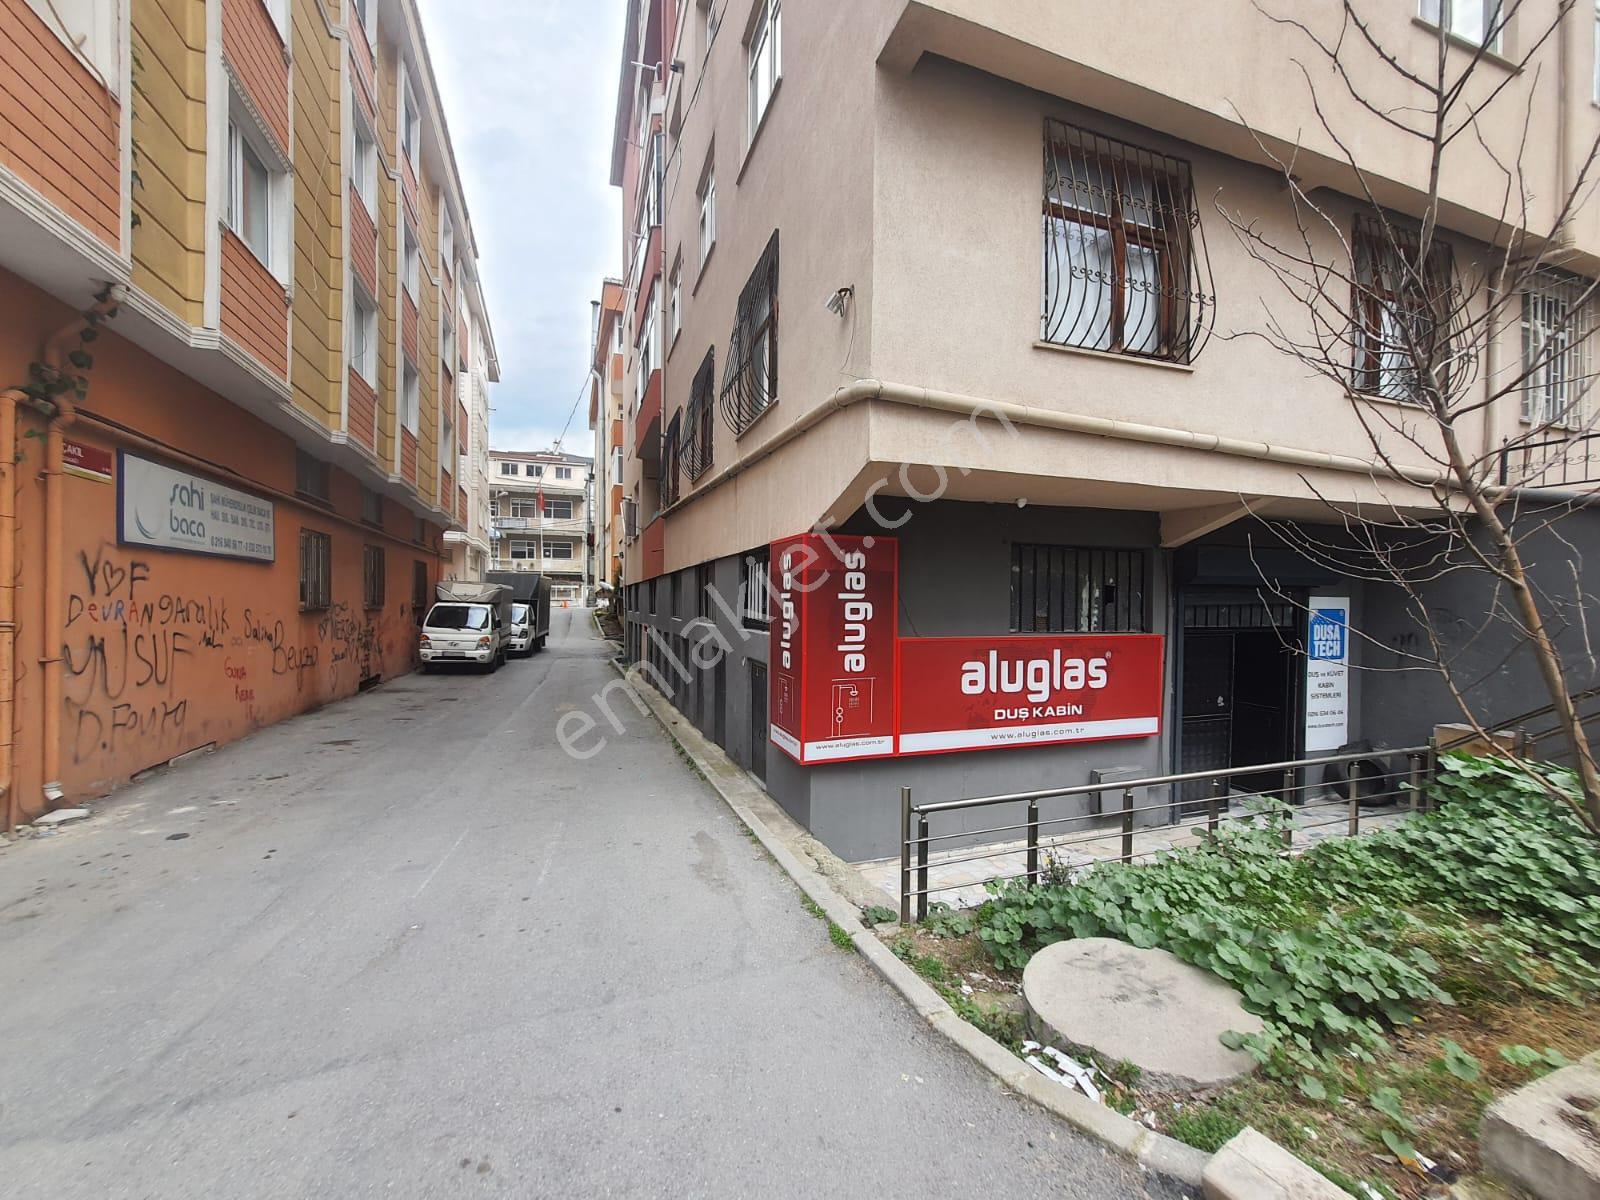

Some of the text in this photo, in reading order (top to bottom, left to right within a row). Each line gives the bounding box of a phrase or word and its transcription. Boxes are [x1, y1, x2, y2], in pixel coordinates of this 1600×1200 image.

[170, 480, 204, 511] sahi
[170, 508, 205, 538] baca
[780, 551, 794, 670] aluglas
[837, 551, 873, 673] aluglas
[1313, 624, 1341, 641] DUSA
[1313, 640, 1341, 658] TECH
[960, 648, 1108, 703] aluglas
[994, 702, 1083, 722] DUŞ KABİN
[815, 738, 885, 751] www.aluglas.com.tr
[990, 727, 1086, 740] www.aluglas.com.tr
